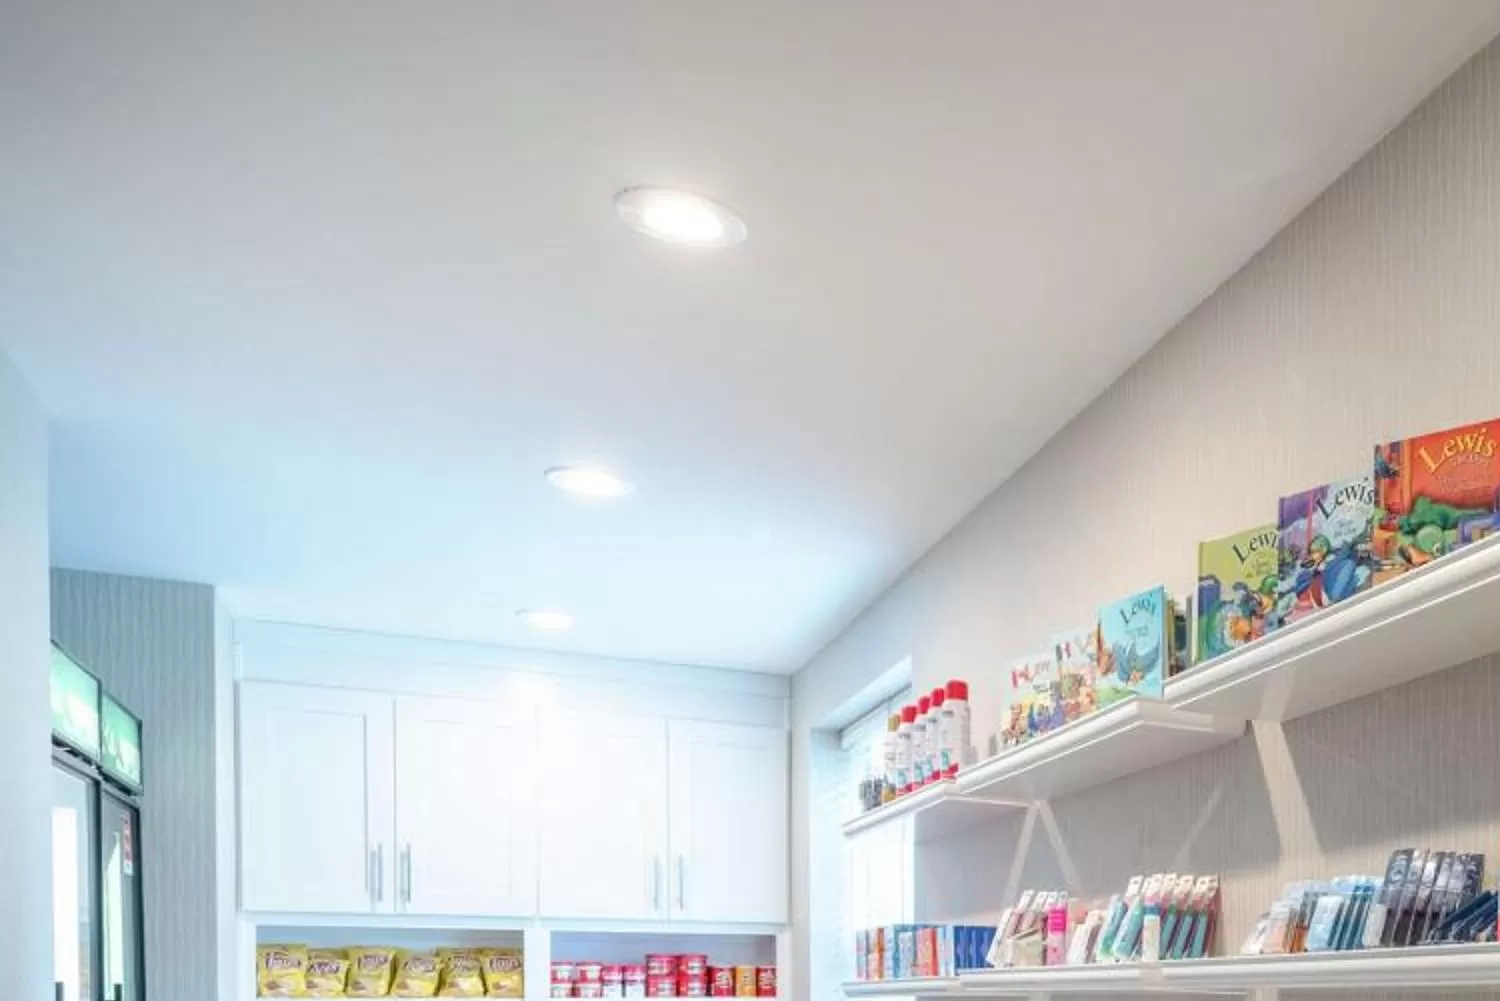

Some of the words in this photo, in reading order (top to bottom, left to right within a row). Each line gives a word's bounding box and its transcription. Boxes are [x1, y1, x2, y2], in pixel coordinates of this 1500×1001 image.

[1418, 427, 1498, 475] Lewis
[1315, 476, 1375, 520] Lewis
[1232, 525, 1280, 564] Lewi
